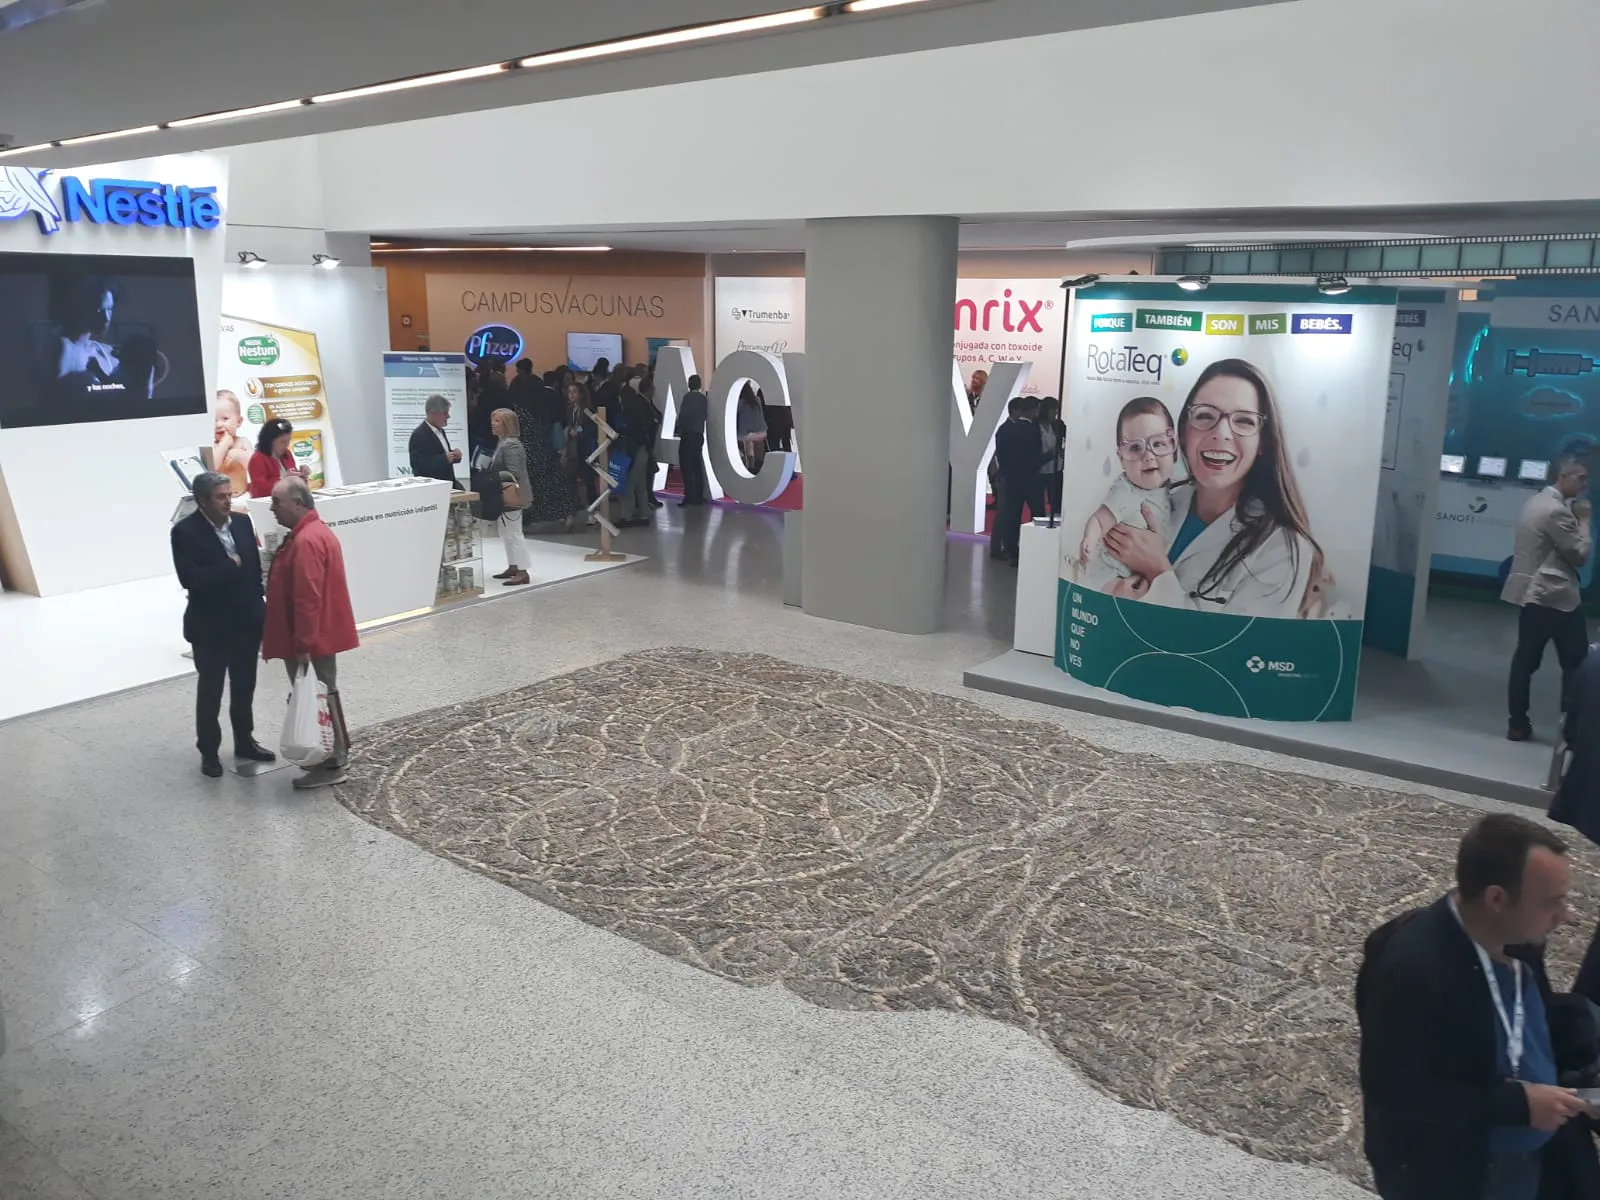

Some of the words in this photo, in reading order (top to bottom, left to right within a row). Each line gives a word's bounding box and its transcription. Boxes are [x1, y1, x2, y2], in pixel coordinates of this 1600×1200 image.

[60, 176, 220, 229] Nestlé
[1145, 314, 1193, 327] TAMBIÉN
[1211, 320, 1237, 330] SON
[1256, 319, 1279, 330] MIS
[1548, 304, 1600, 323] SAN
[239, 346, 277, 357] Nestum
[469, 332, 519, 357] Pfizer
[1008, 342, 1043, 351] toxoide
[1087, 344, 1162, 381] RotaTeq
[338, 512, 373, 526] mundiales
[384, 507, 414, 519] nutrición
[1436, 512, 1475, 523] SANOFI
[1072, 607, 1098, 626] MUNDO
[1070, 638, 1080, 650] NO
[1268, 661, 1295, 671] MSD
